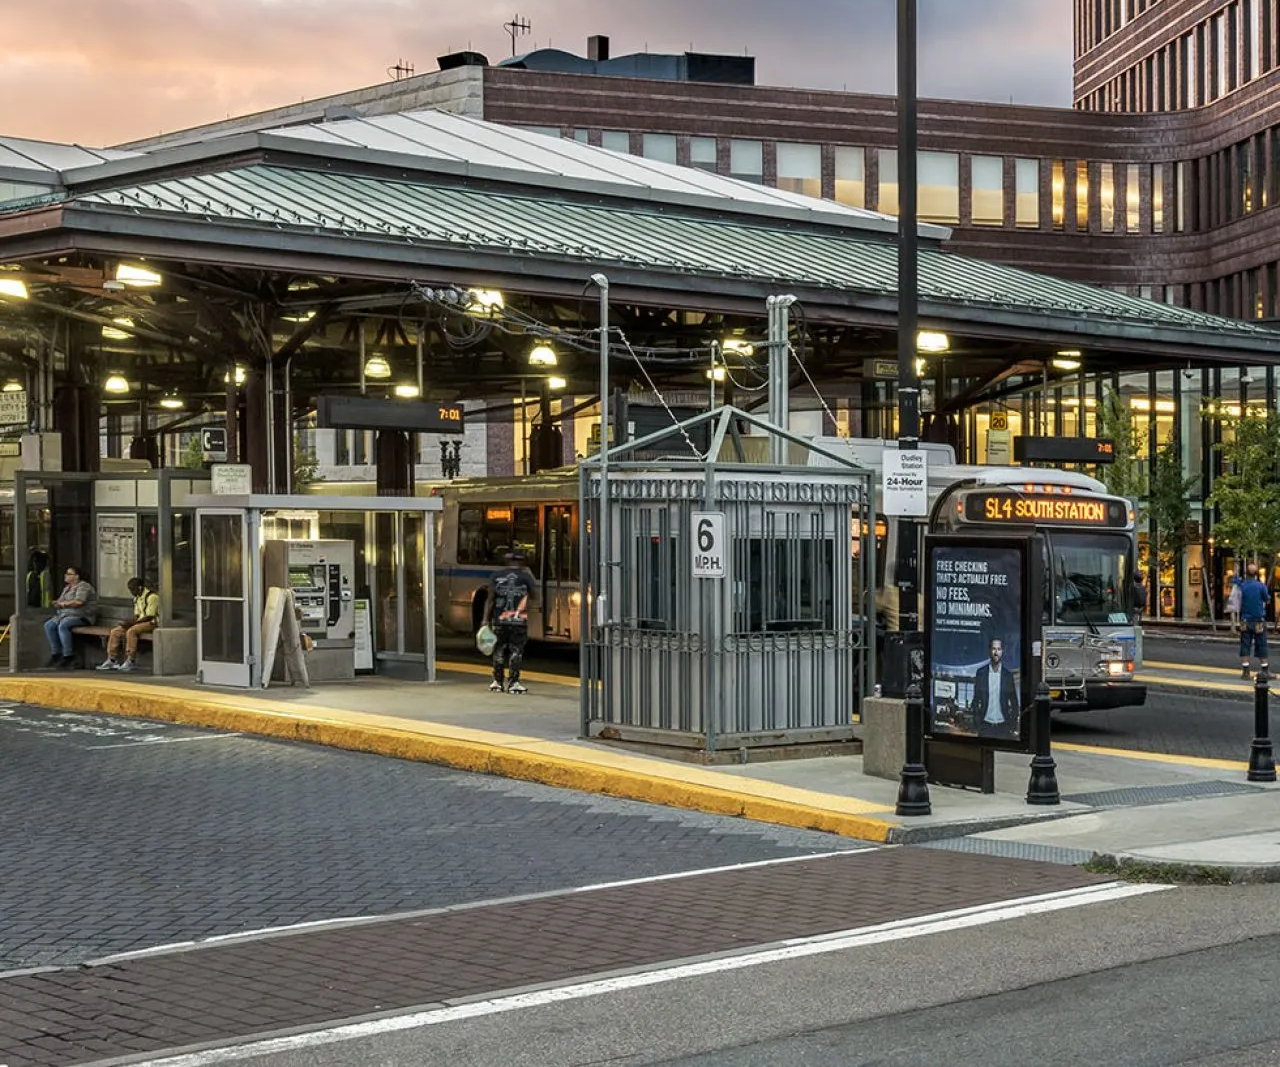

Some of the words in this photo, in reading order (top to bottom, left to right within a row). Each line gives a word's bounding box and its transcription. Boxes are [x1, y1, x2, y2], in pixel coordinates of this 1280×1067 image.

[438, 408, 460, 421] 7:01
[993, 417, 1005, 428] 20
[901, 454, 922, 462] Dudley
[887, 477, 924, 485] 24-Hour
[986, 498, 1012, 518] SL4
[1015, 499, 1054, 519] SOUTH
[1055, 502, 1104, 521] STATION
[697, 518, 715, 553] 6
[936, 560, 953, 572] FREE
[954, 561, 988, 573] CHECKING
[936, 572, 957, 584] THAT'S
[958, 573, 989, 585] ACTUALLY
[989, 574, 1008, 586] FREE.
[936, 586, 948, 600] NO
[948, 587, 971, 602] FEES,
[936, 601, 947, 615] NO
[948, 602, 993, 618] MINIMUMS.
